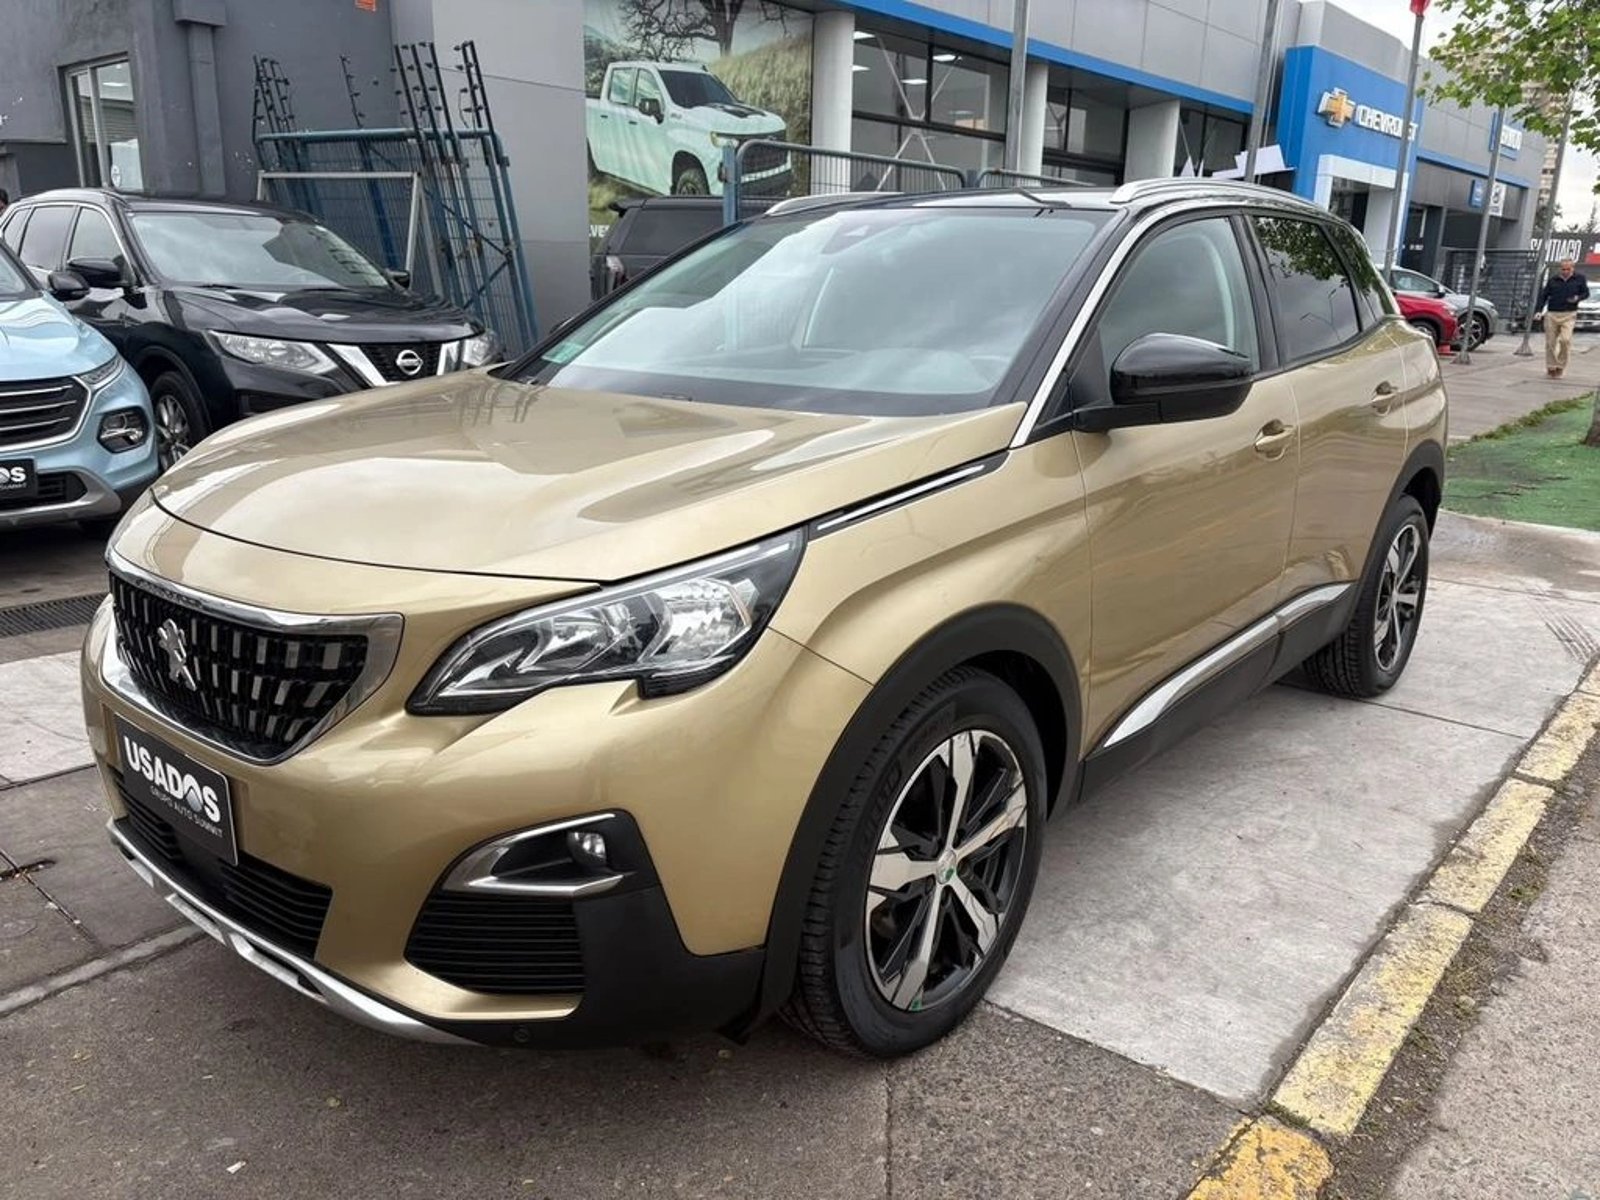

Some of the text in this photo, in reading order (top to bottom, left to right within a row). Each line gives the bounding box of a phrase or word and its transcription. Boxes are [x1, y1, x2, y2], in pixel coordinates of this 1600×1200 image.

[1357, 104, 1418, 141] CHEVROET
[123, 735, 221, 823] USADOS
[173, 801, 193, 820] AUTO
